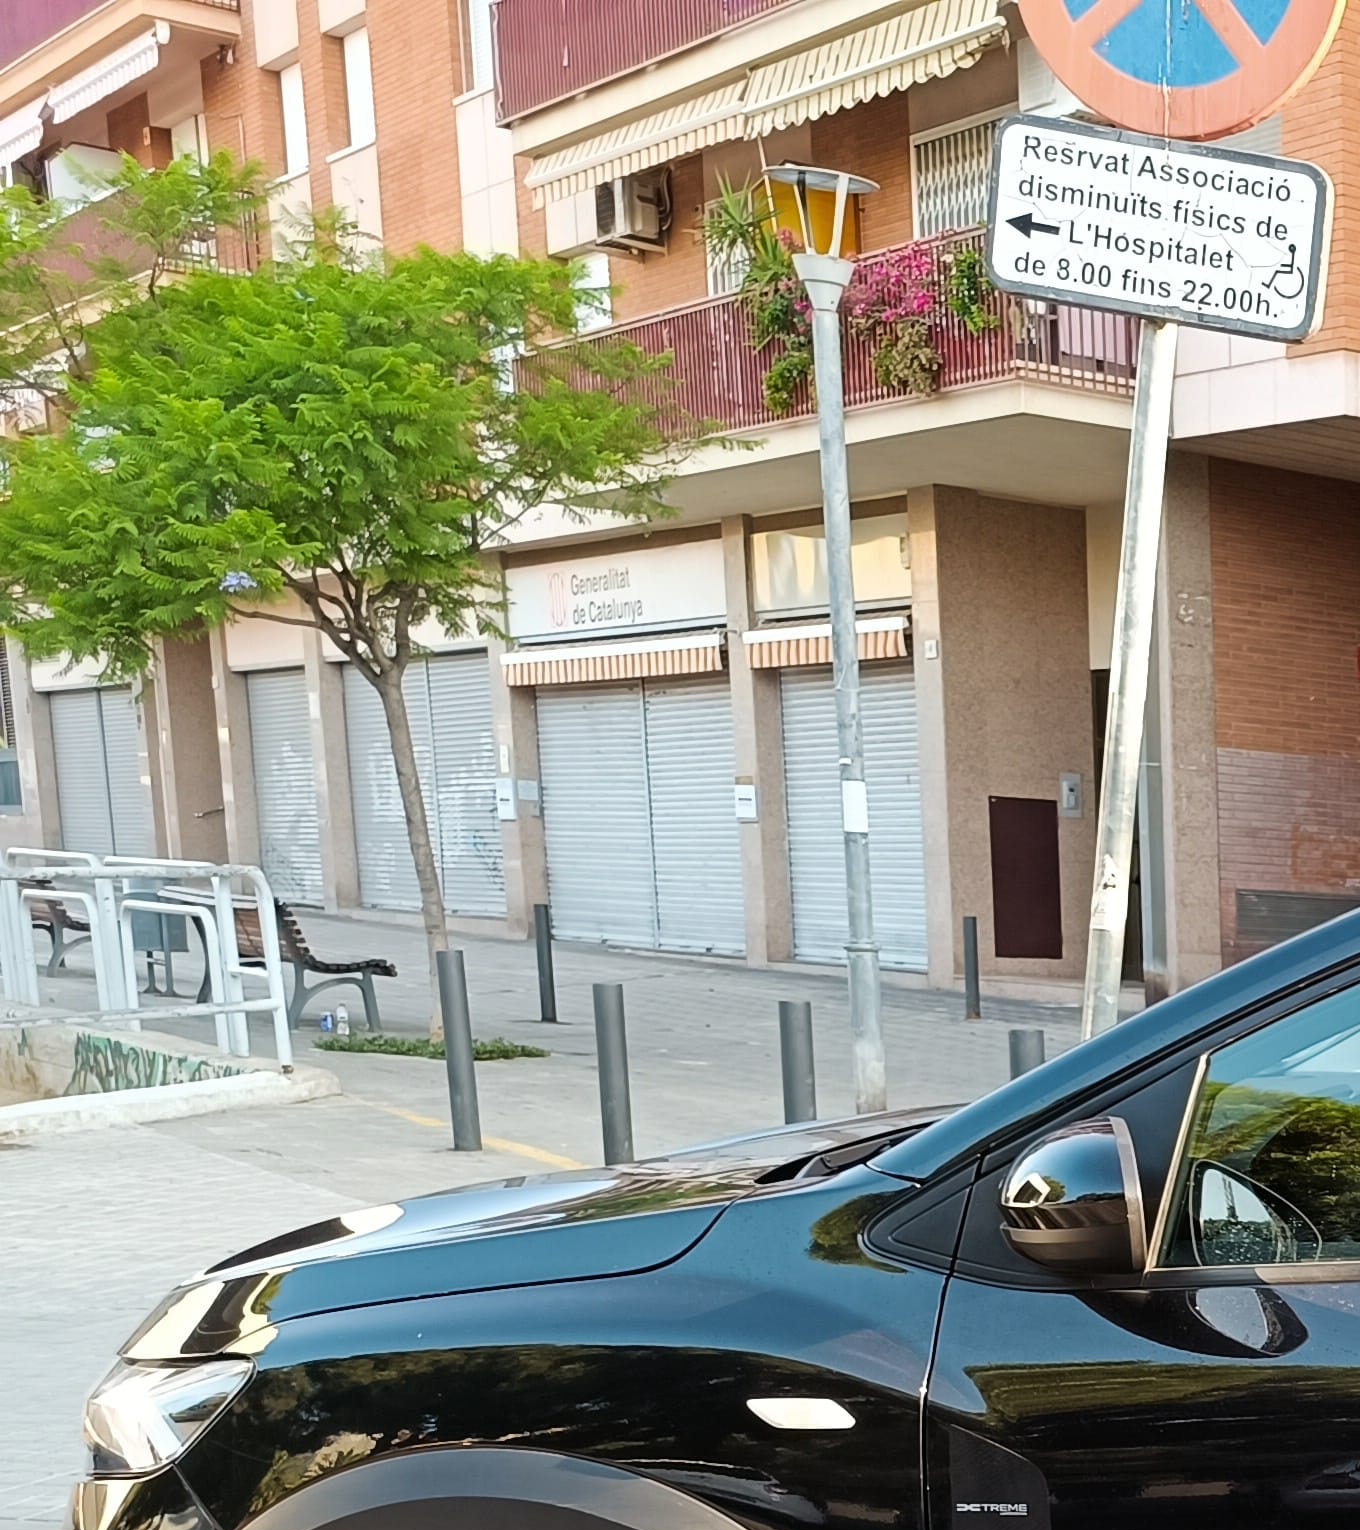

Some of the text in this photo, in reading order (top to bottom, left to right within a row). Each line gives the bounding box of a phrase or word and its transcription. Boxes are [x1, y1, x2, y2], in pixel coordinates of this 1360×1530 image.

[1023, 135, 1292, 202] Resrvat Associació
[1018, 175, 1289, 240] disminuïts físics de
[1068, 220, 1234, 271] L'Hospitalet
[1014, 252, 1279, 318] de 8.00 fins 22.00h.
[571, 566, 630, 596] Generalitat
[573, 598, 643, 625] de Catalunya
